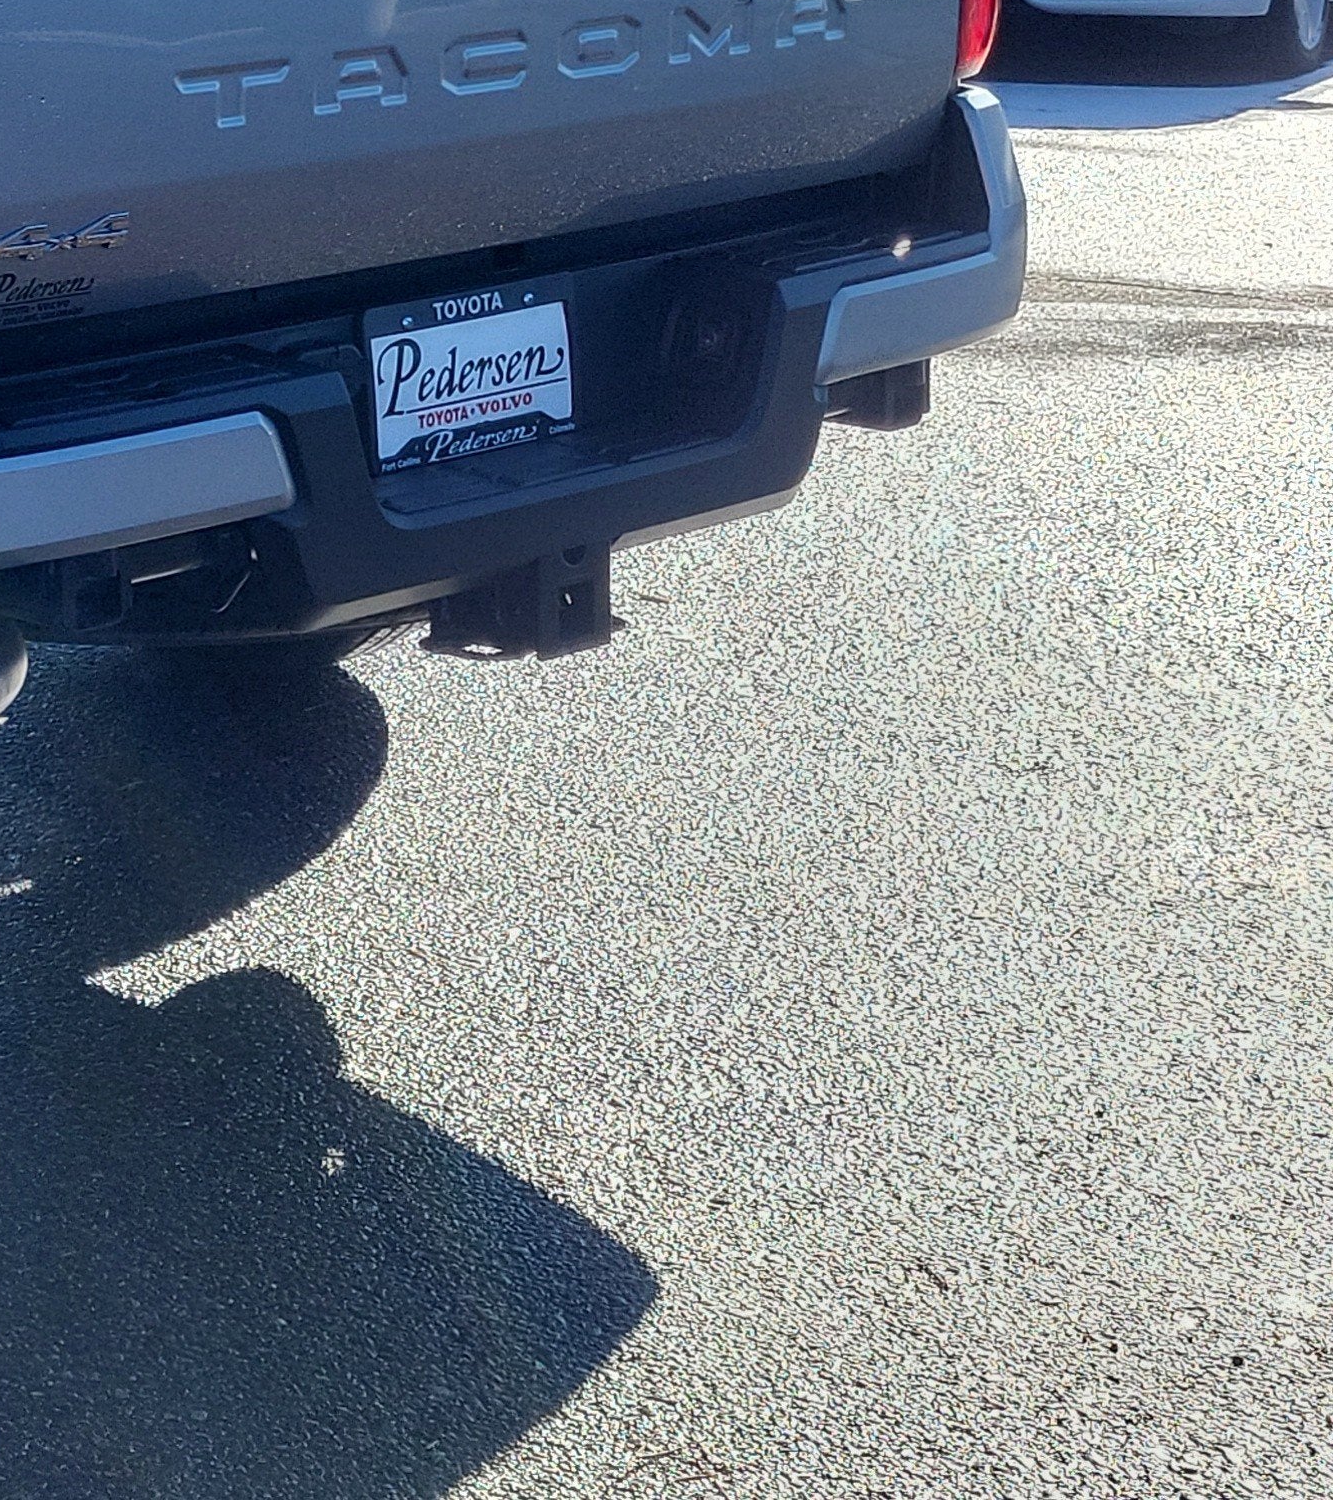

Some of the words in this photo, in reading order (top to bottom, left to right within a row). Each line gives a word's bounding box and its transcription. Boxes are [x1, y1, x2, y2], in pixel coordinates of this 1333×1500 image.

[433, 291, 504, 321] TOYOTA
[377, 338, 565, 418] Pedersen
[418, 406, 469, 429] TOYOTA
[478, 392, 533, 416] VOLVO
[424, 425, 538, 463] Pedersen
